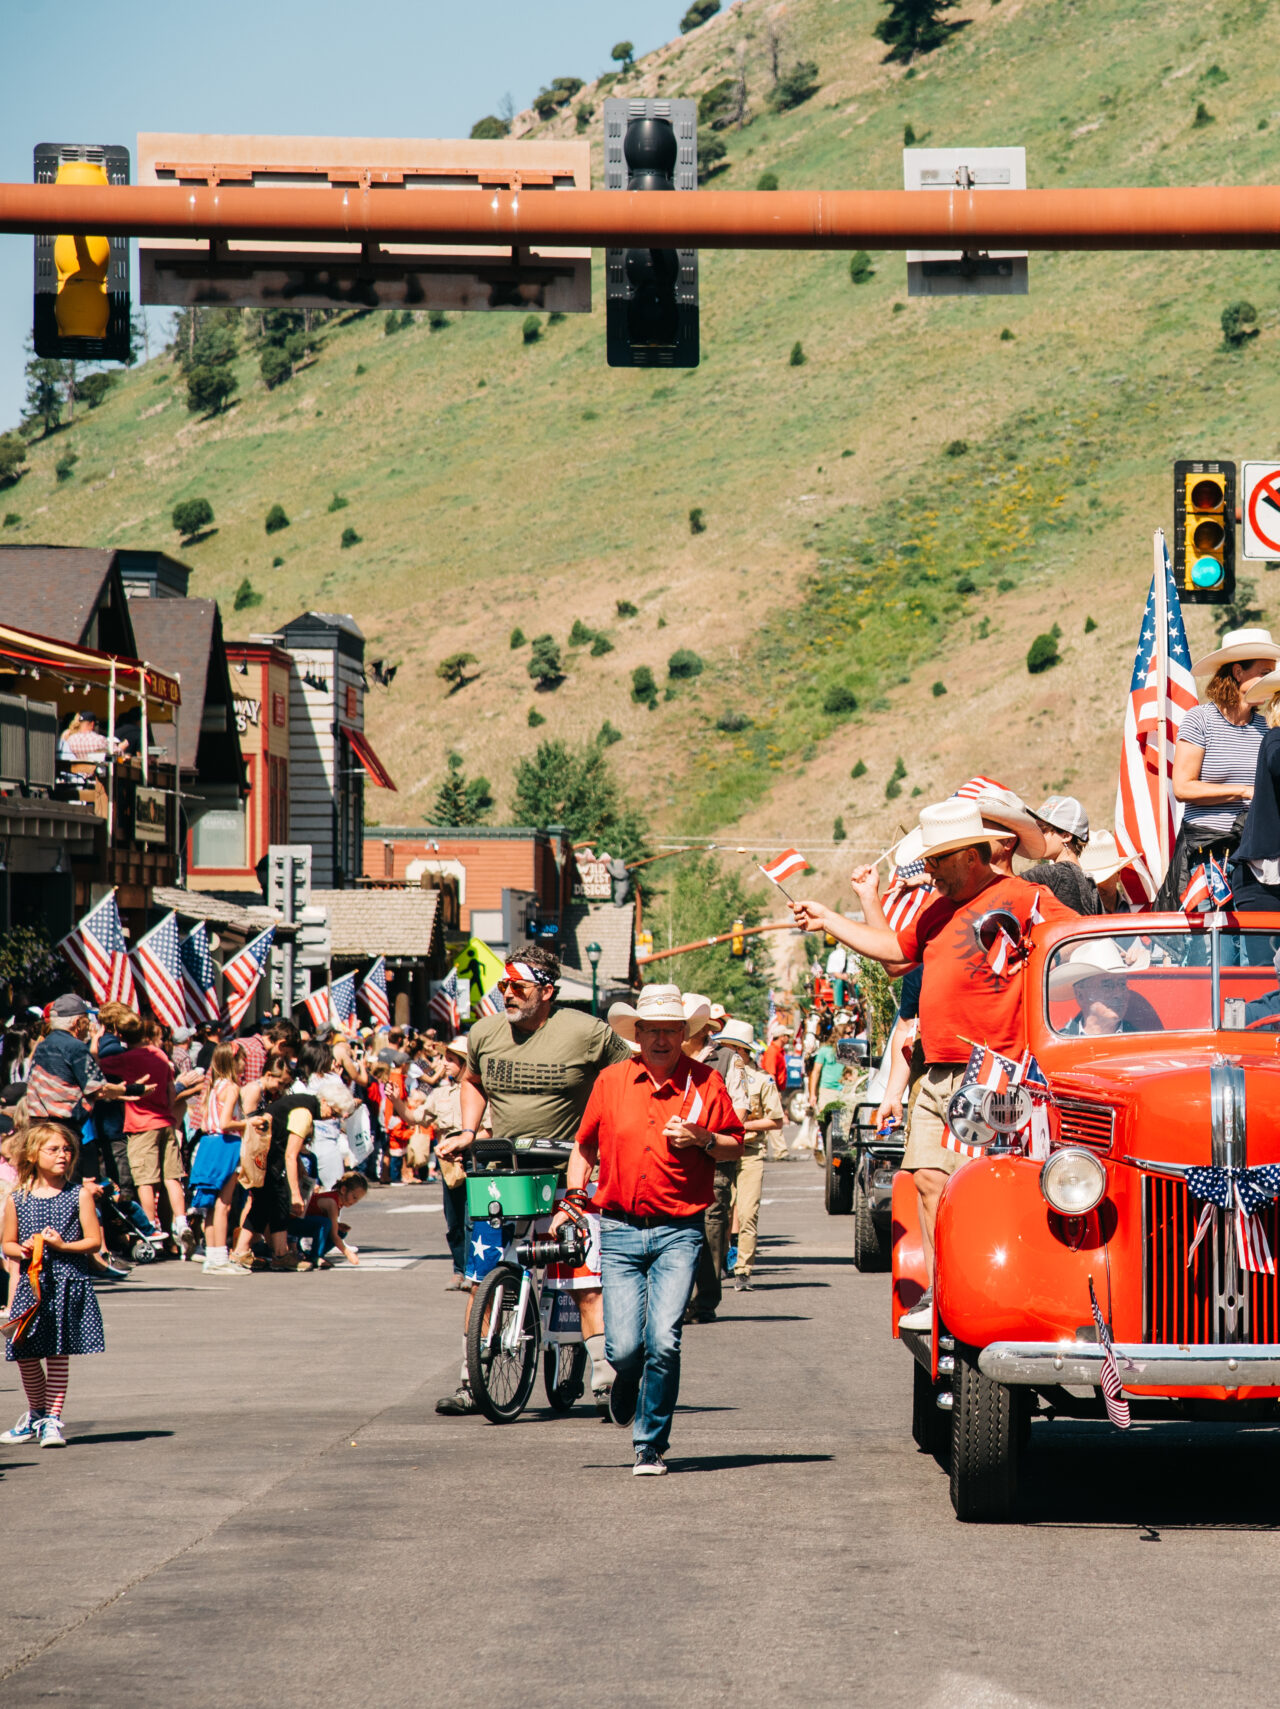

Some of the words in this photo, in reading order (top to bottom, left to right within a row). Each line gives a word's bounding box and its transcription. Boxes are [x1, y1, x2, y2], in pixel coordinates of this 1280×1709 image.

[576, 862, 606, 874] WILD
[580, 873, 611, 884] WEST
[573, 883, 612, 896] DESIGNS
[557, 1295, 568, 1306] GET
[558, 1311, 568, 1322] AND
[569, 1311, 580, 1322] RIDE
